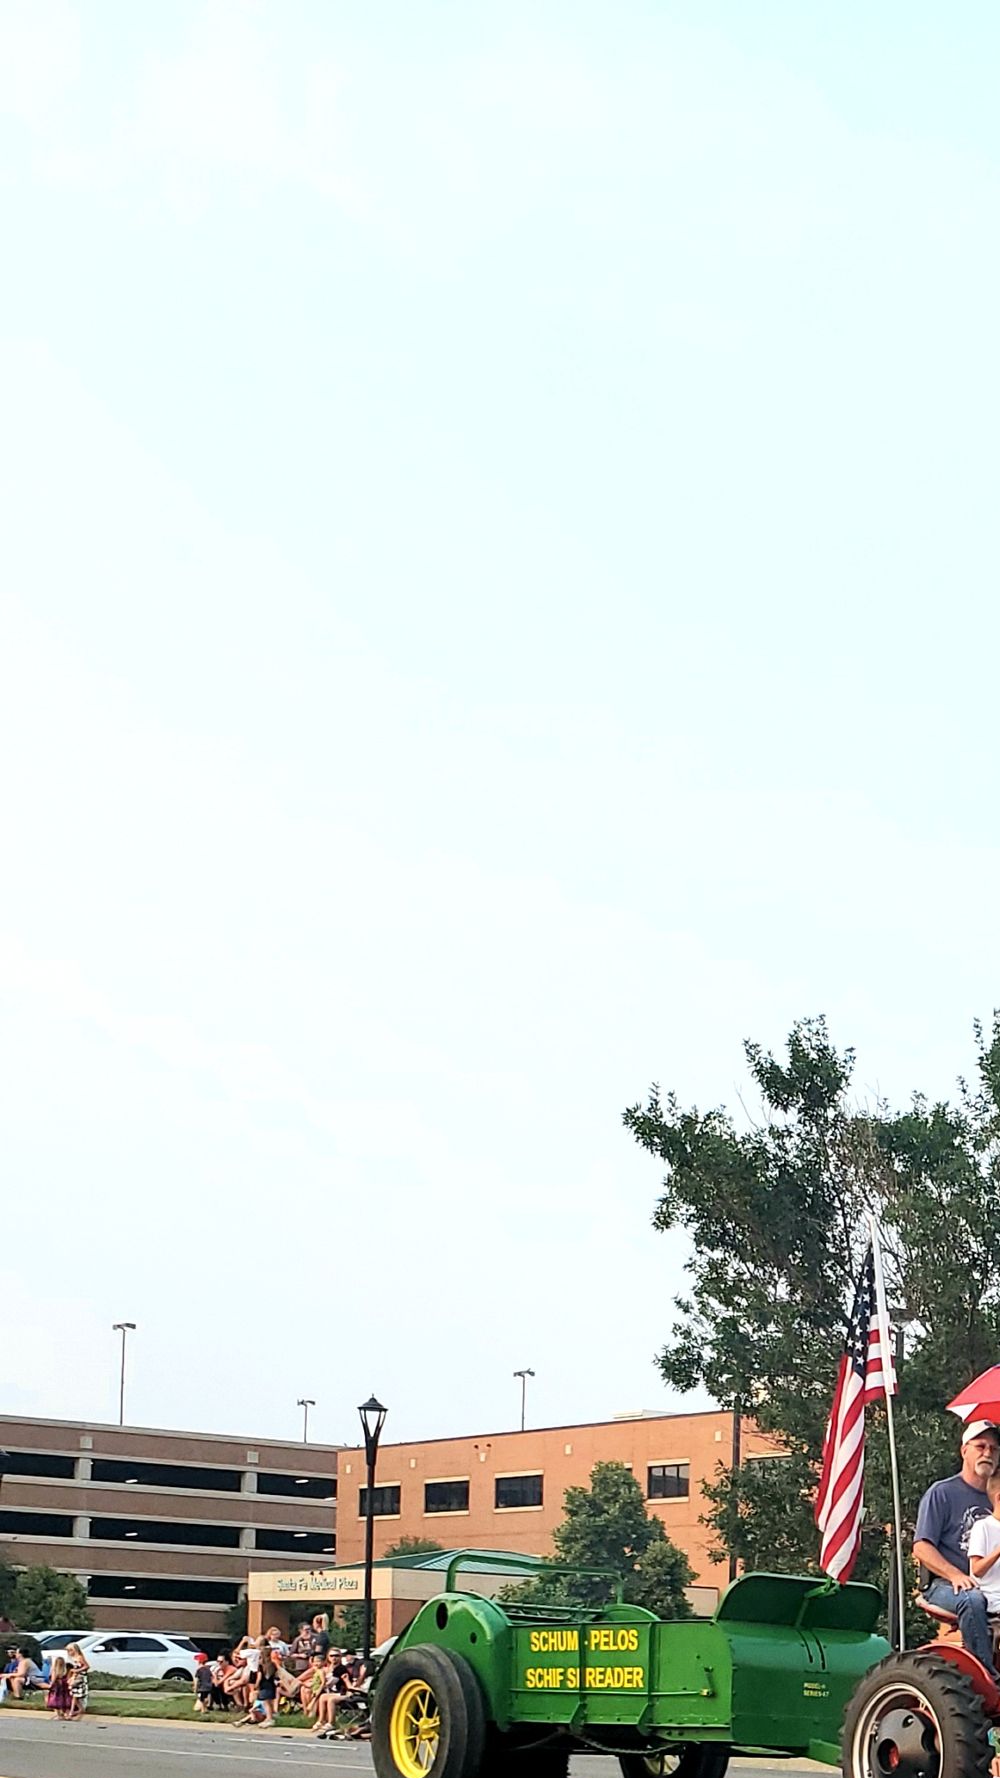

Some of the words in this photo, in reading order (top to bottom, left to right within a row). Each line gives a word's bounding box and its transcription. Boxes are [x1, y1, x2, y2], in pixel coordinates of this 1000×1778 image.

[310, 1577, 336, 1590] Medical
[338, 1577, 358, 1590] Plaza
[531, 1631, 579, 1652] SCHUM
[590, 1629, 639, 1651] PELOS
[526, 1668, 565, 1688] SCHIF
